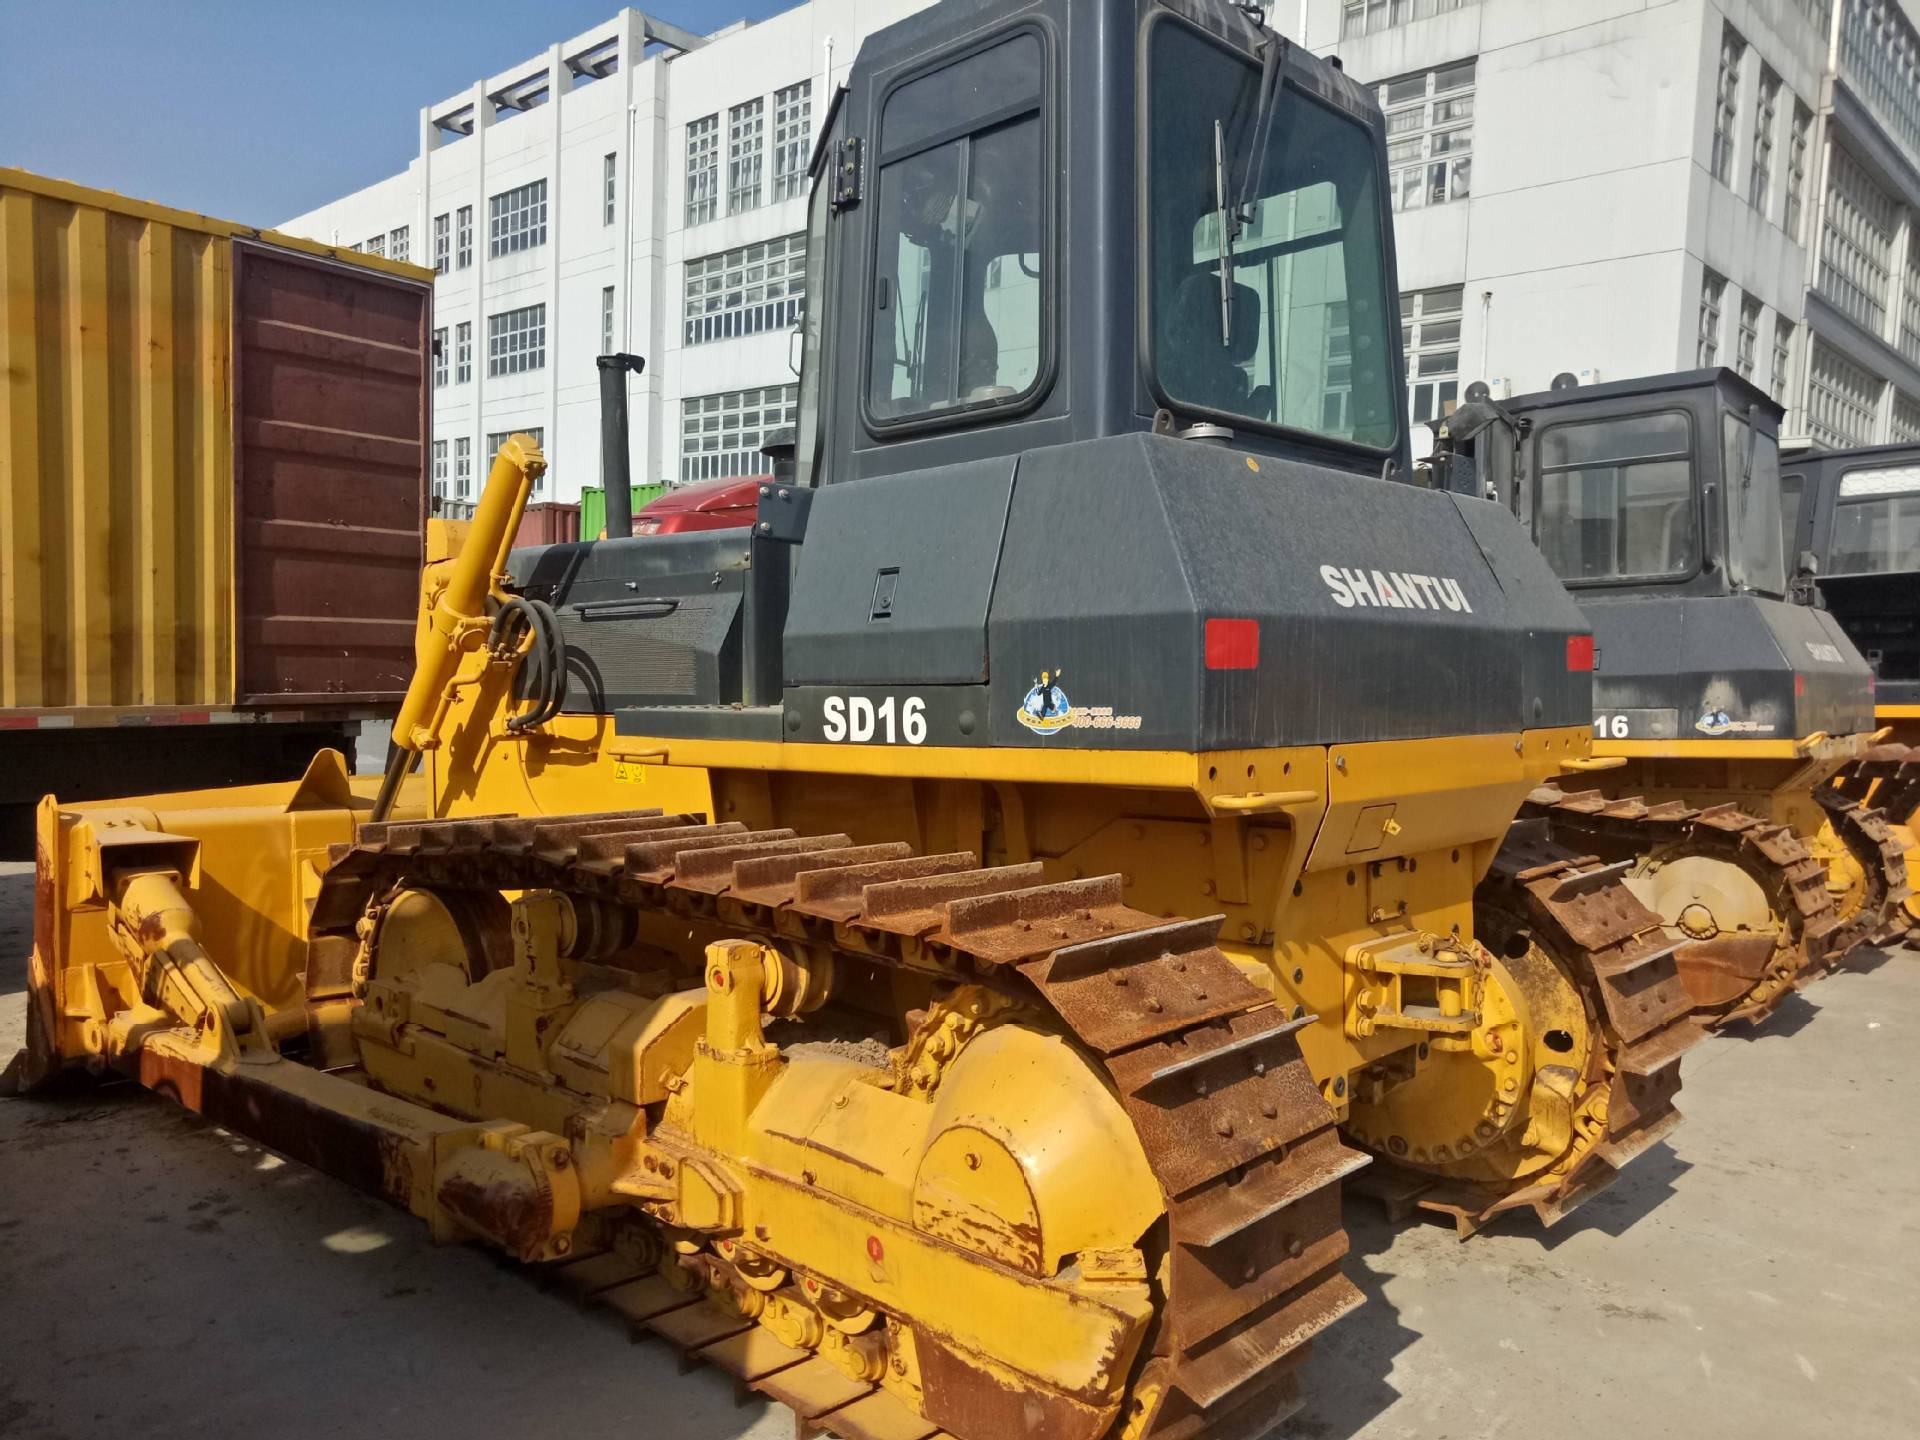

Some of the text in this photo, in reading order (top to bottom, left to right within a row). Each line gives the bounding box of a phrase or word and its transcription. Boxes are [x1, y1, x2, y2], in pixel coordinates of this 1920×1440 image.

[1320, 564, 1473, 614] SHANTUI
[823, 695, 927, 745] SD16
[1594, 715, 1629, 738] 16
